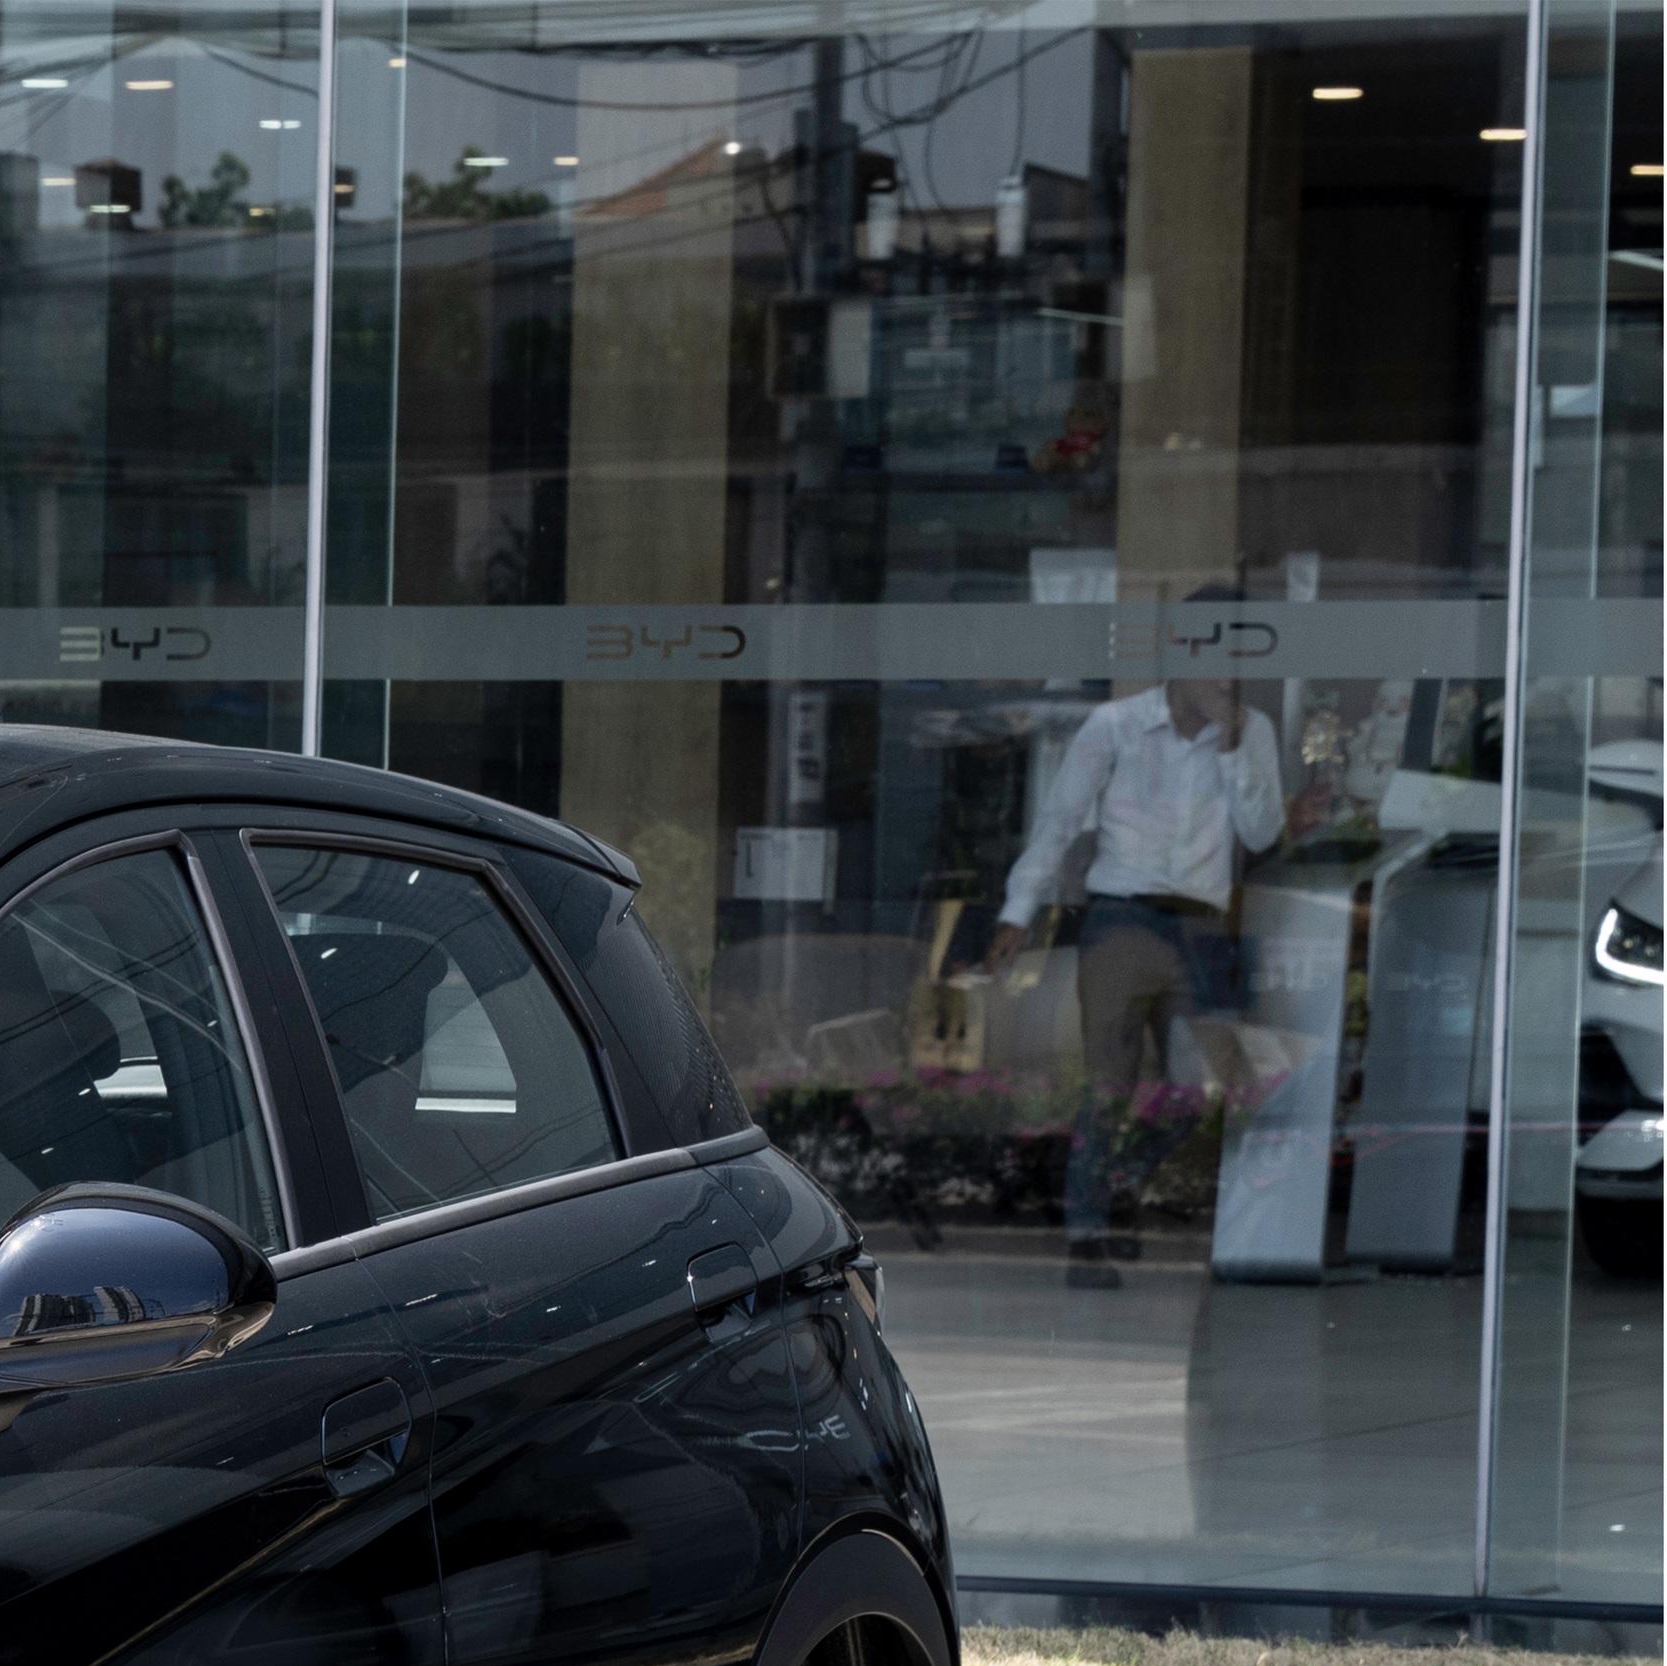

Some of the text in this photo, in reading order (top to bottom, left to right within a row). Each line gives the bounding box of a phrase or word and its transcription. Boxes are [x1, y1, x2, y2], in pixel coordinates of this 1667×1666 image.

[59, 627, 212, 661] BYD
[586, 625, 745, 660] BYD
[1109, 621, 1278, 658] BYD
